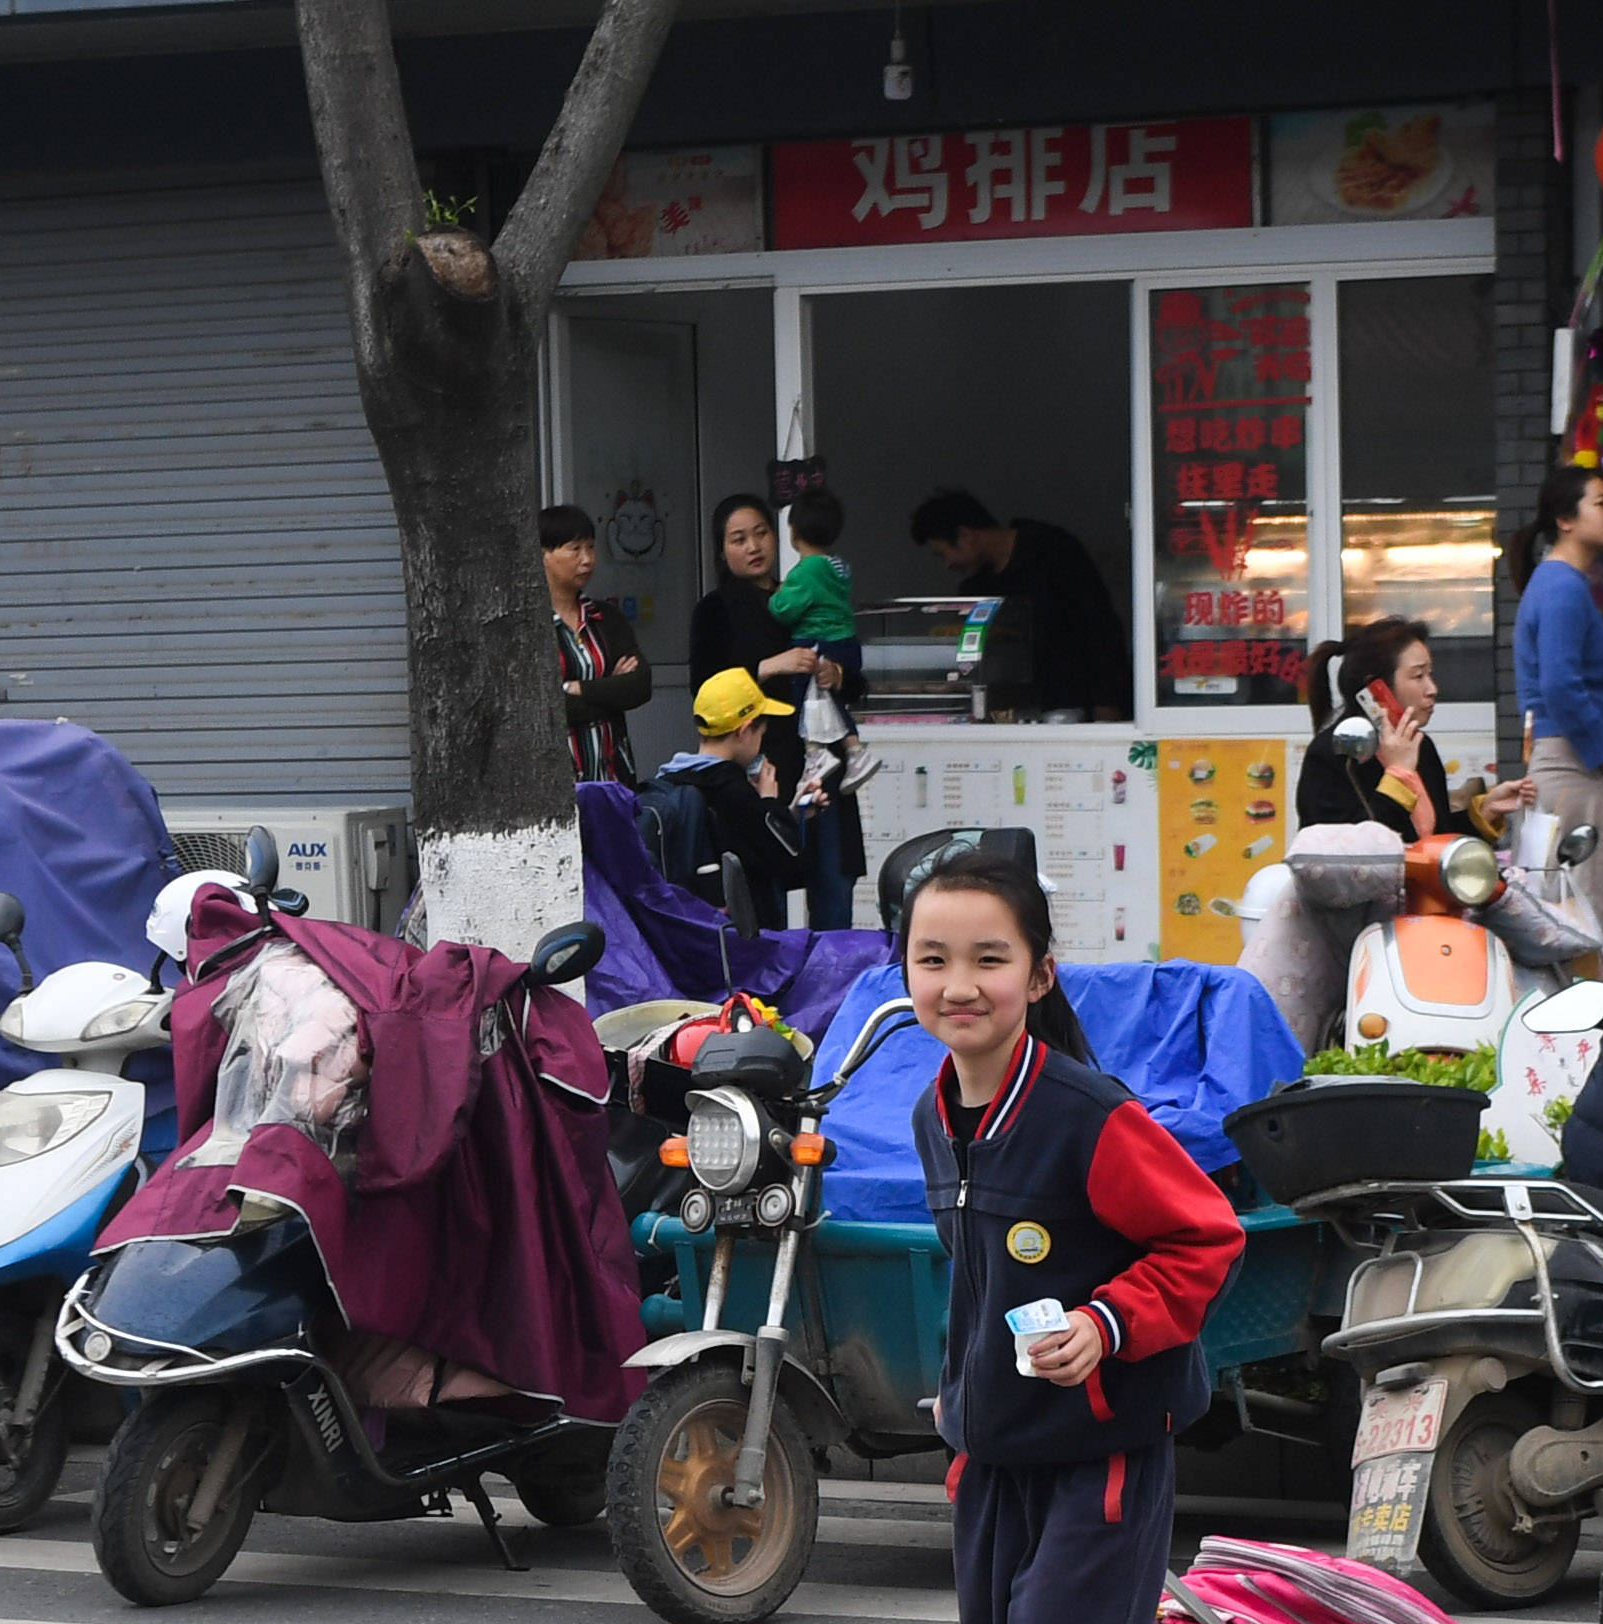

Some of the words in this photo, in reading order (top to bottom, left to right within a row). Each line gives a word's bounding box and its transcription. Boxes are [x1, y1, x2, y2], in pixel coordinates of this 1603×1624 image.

[851, 120, 1177, 231] 鸡排店
[1184, 590, 1284, 626] 现炸的
[287, 842, 327, 857] AUX
